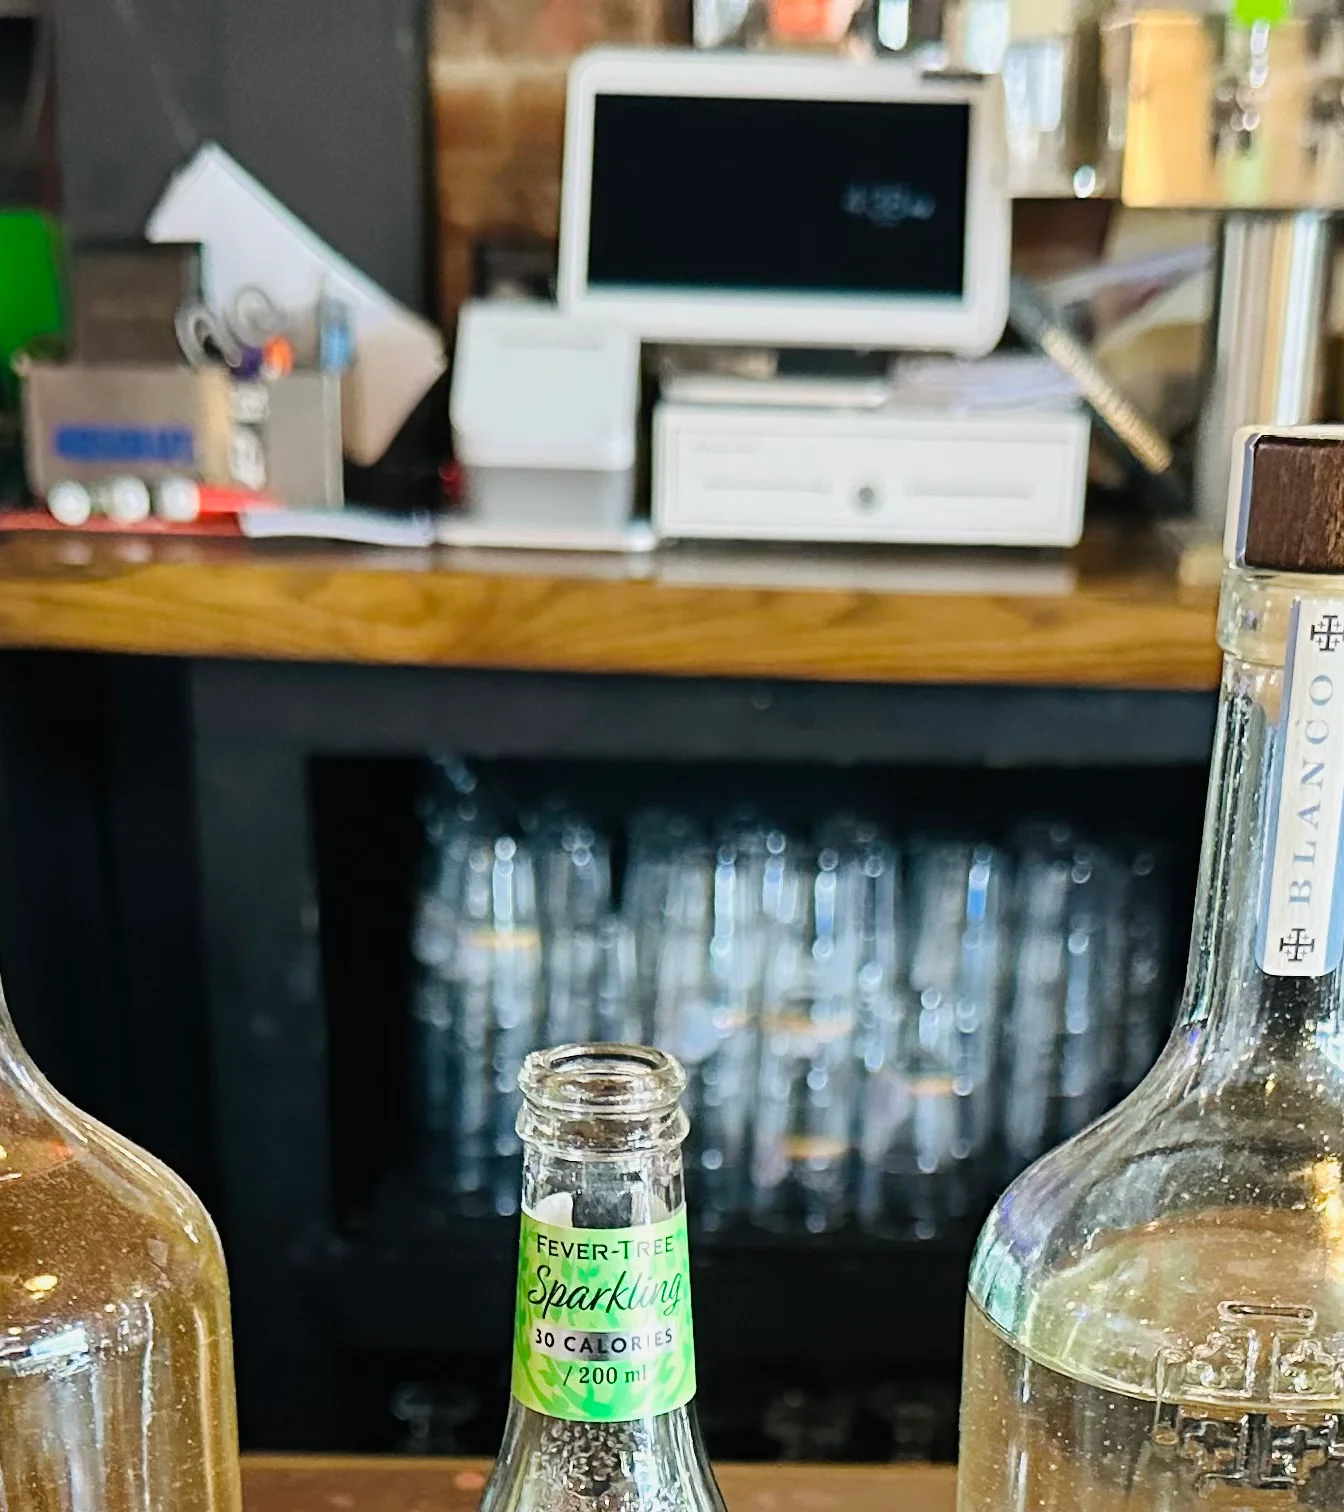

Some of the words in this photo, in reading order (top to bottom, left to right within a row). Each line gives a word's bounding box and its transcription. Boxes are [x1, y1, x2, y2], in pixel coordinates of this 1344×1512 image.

[1288, 673, 1334, 905] BLANCO
[536, 1234, 674, 1261] FEVER-TREE
[527, 1264, 682, 1319] Sparkling
[535, 1328, 555, 1348] 30
[563, 1327, 674, 1354] CALORIES
[578, 1366, 618, 1385] 200
